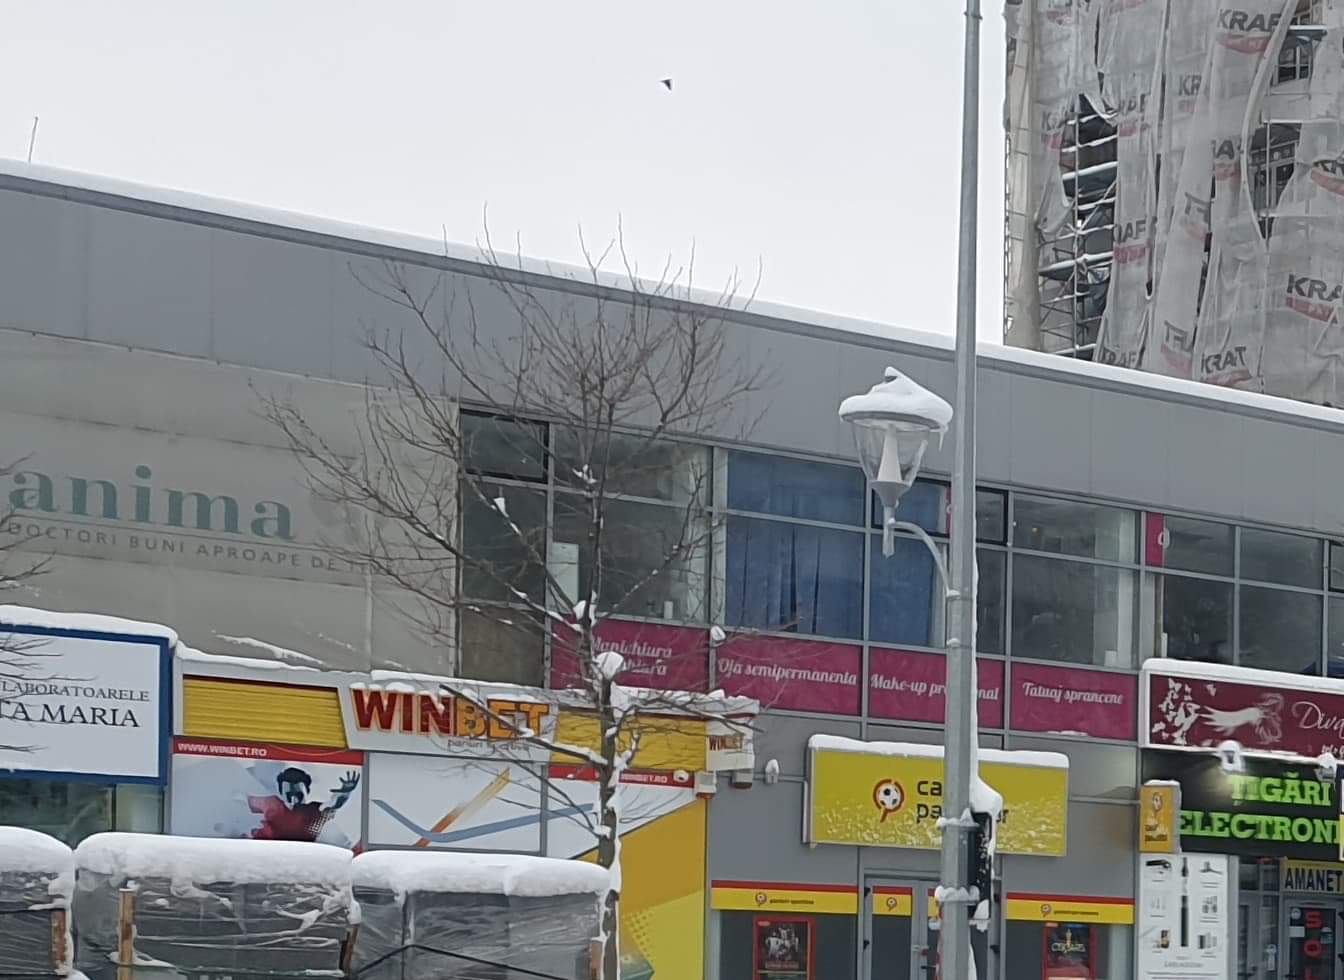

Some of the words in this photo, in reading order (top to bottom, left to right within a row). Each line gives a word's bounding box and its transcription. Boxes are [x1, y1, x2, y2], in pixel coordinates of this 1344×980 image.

[1217, 8, 1282, 33] KRAF
[9, 464, 296, 541] anima
[8, 522, 117, 546] DOCTORI
[128, 534, 186, 554] BUNI
[195, 541, 301, 568] APROAPE
[310, 556, 337, 571] DE
[1, 682, 150, 702] LABORATOARELE
[870, 671, 928, 696] Make-up
[1022, 681, 1063, 704] Tatuaj
[42, 703, 140, 728] MARIA
[352, 688, 549, 740] WINBET
[177, 742, 268, 757] WWW.WINBET.RO
[1284, 867, 1343, 892] AMANET
